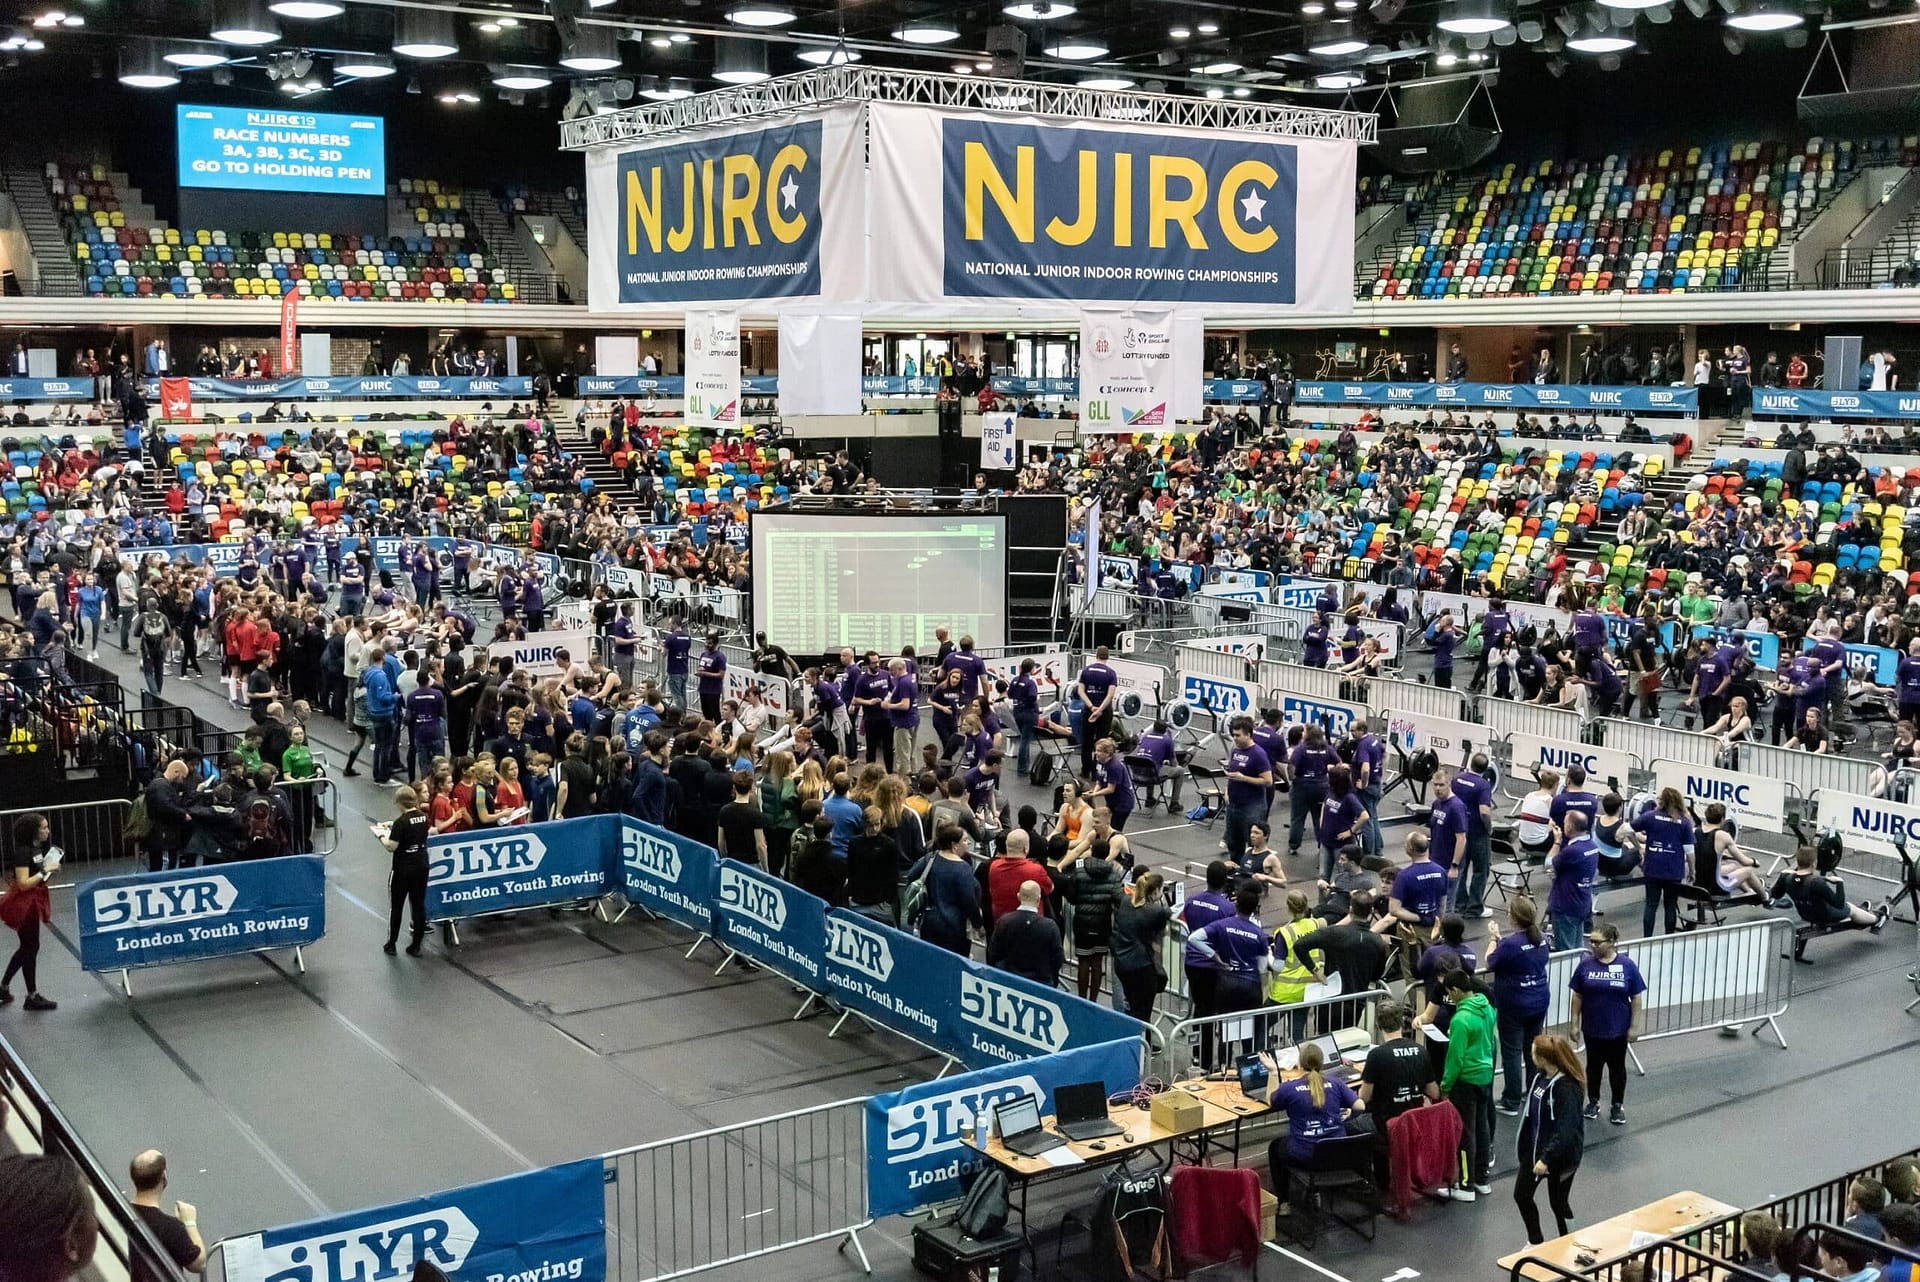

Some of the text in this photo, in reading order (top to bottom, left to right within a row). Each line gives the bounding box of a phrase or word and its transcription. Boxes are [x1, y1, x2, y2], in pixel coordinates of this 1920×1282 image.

[247, 112, 316, 126] NJIRC19
[213, 128, 351, 147] RACE NUMBERS
[223, 144, 342, 162] 3A, 3B, 3C, 3D
[192, 160, 371, 180] GO TO HOLDING PEN
[626, 144, 808, 256] NJIRC
[964, 141, 1279, 254] NJIRC
[627, 261, 808, 284] NATIONAL JUNIOR INDOOR ROWING CHAMPIONSHIPS
[965, 262, 1279, 284] NATIONAL JUNIOR INDOOR ROWING CHAMPIONSHIPS
[360, 381, 392, 391] NJIRC
[469, 380, 500, 390] NJIRC
[587, 381, 615, 389] NJIRC
[1299, 386, 1324, 397] NJIRC
[1387, 388, 1414, 399] NJIRC
[1483, 389, 1513, 400] NJIRC
[1589, 391, 1622, 403] NJIRC
[1762, 394, 1799, 408] NJIRC
[690, 395, 703, 414] GLL
[1088, 400, 1110, 420] GLL
[983, 428, 1004, 438] FIRST
[987, 441, 1000, 452] AID
[1125, 637, 1131, 647] C
[630, 715, 649, 727] OLLIE
[1540, 746, 1597, 775] NJIRC
[1686, 775, 1750, 806] NJIRC
[409, 815, 426, 824] STAFF
[441, 870, 605, 904] London Youth Rowing
[625, 872, 657, 896] London
[658, 884, 682, 906] Youth
[1193, 900, 1219, 911] VOLUNTEER
[116, 915, 310, 952] London Youth Rowing
[1226, 927, 1258, 940] VOLUNTEER
[728, 918, 819, 977] London Youth Rowing
[1588, 971, 1625, 980] NJIRC19
[825, 966, 938, 1033] London Youth Rowing
[971, 1032, 1026, 1062] London
[1393, 1047, 1419, 1057] STAFF
[908, 1156, 983, 1189] London
